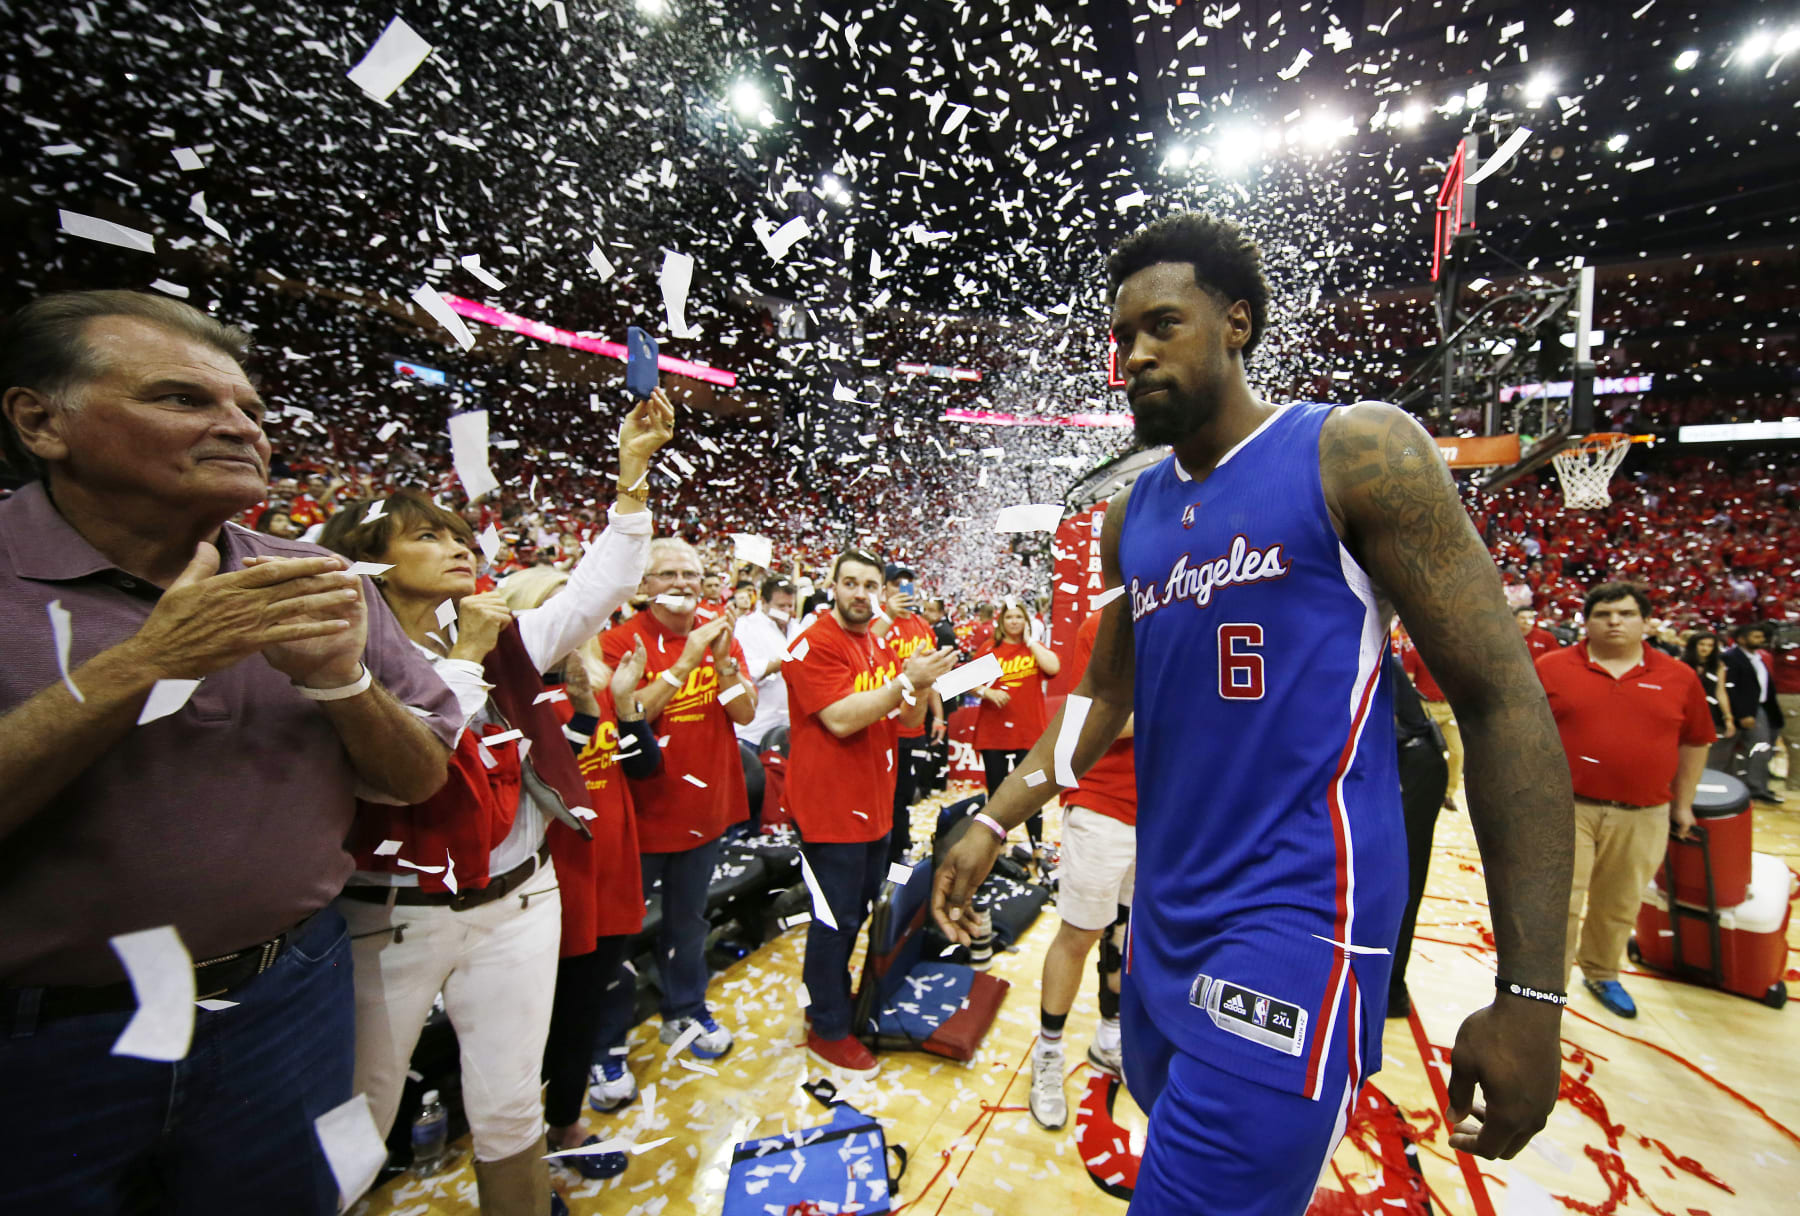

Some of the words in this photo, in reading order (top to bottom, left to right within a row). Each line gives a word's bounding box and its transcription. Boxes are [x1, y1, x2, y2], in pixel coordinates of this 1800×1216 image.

[1130, 576, 1158, 622] Los
[1161, 535, 1292, 608] Angeles
[1217, 623, 1265, 700] 6
[1223, 1002, 1247, 1016] adidas
[1272, 1013, 1293, 1029] 2XL
